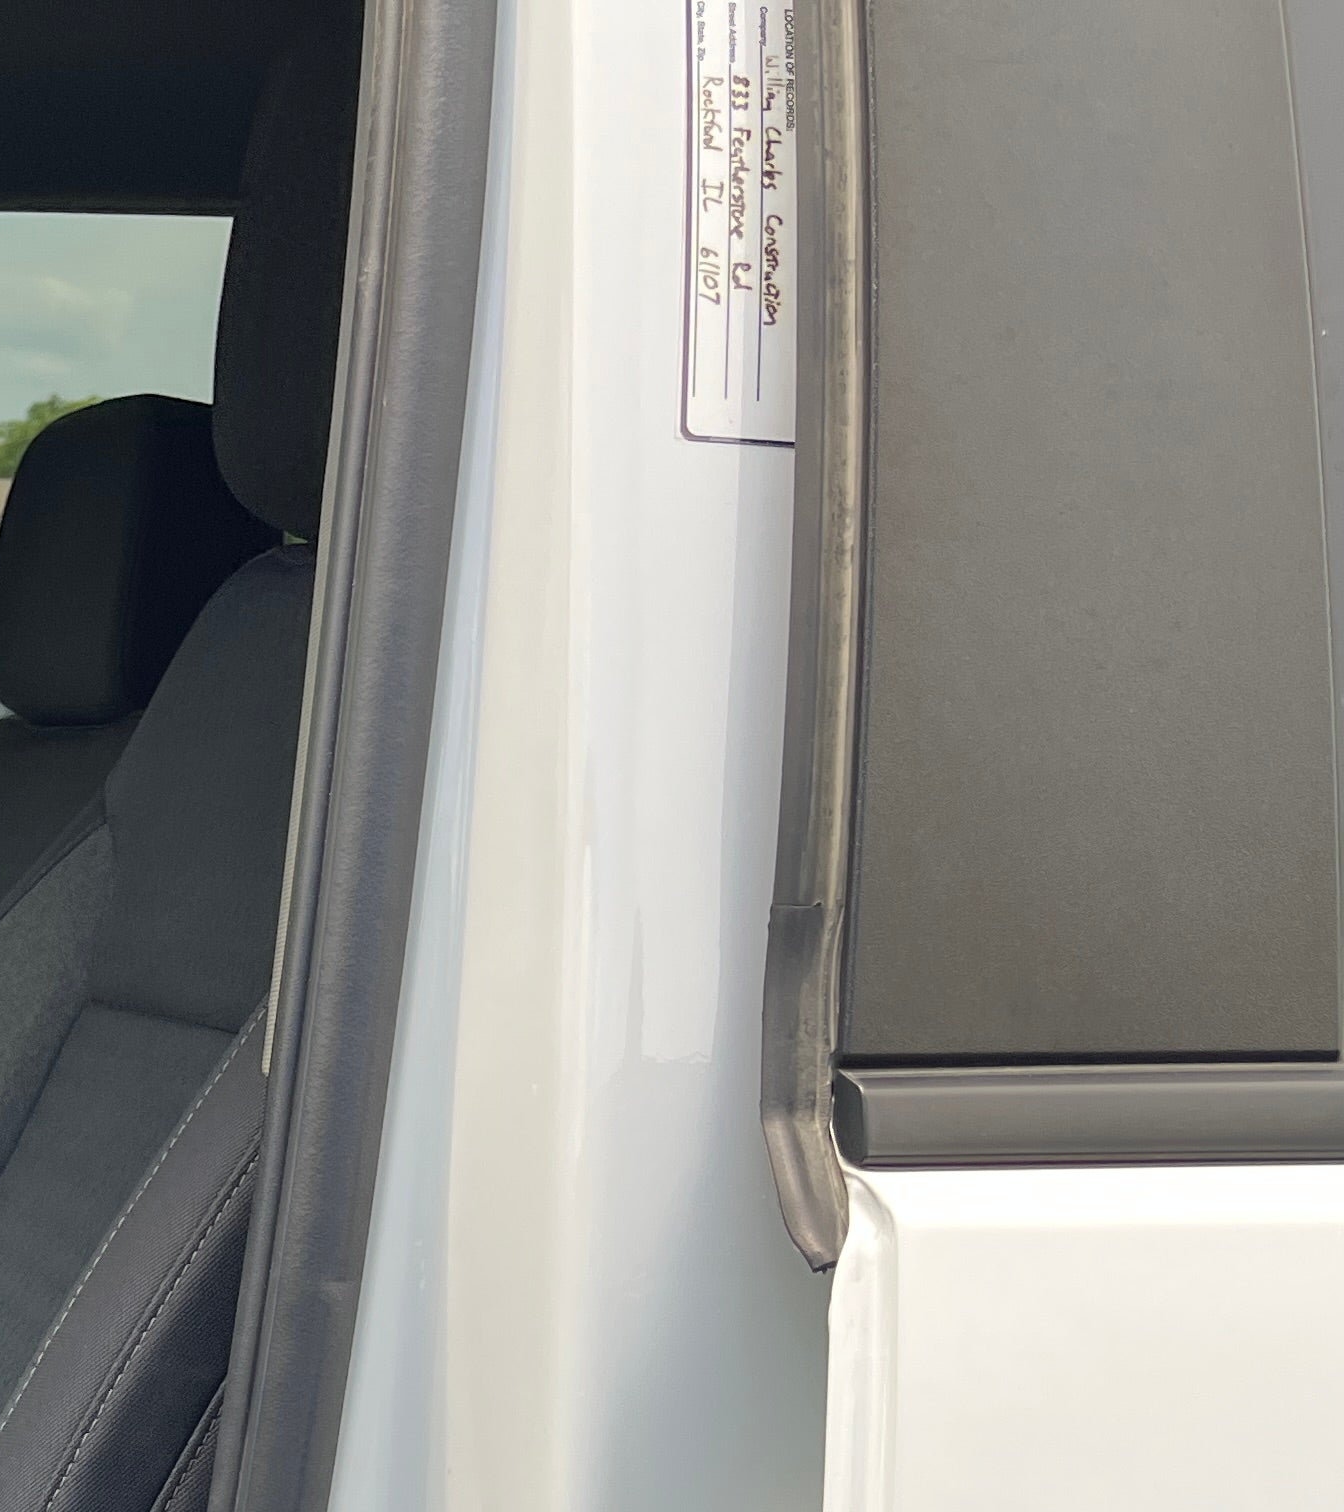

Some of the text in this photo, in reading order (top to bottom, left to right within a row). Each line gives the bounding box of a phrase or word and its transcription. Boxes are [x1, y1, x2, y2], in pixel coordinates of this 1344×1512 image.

[731, 75, 751, 111] 833
[784, 9, 795, 132] LOCATION OF RECORDS:
[699, 76, 724, 305] Rockford IL 61107
[763, 215, 783, 326] Construction
